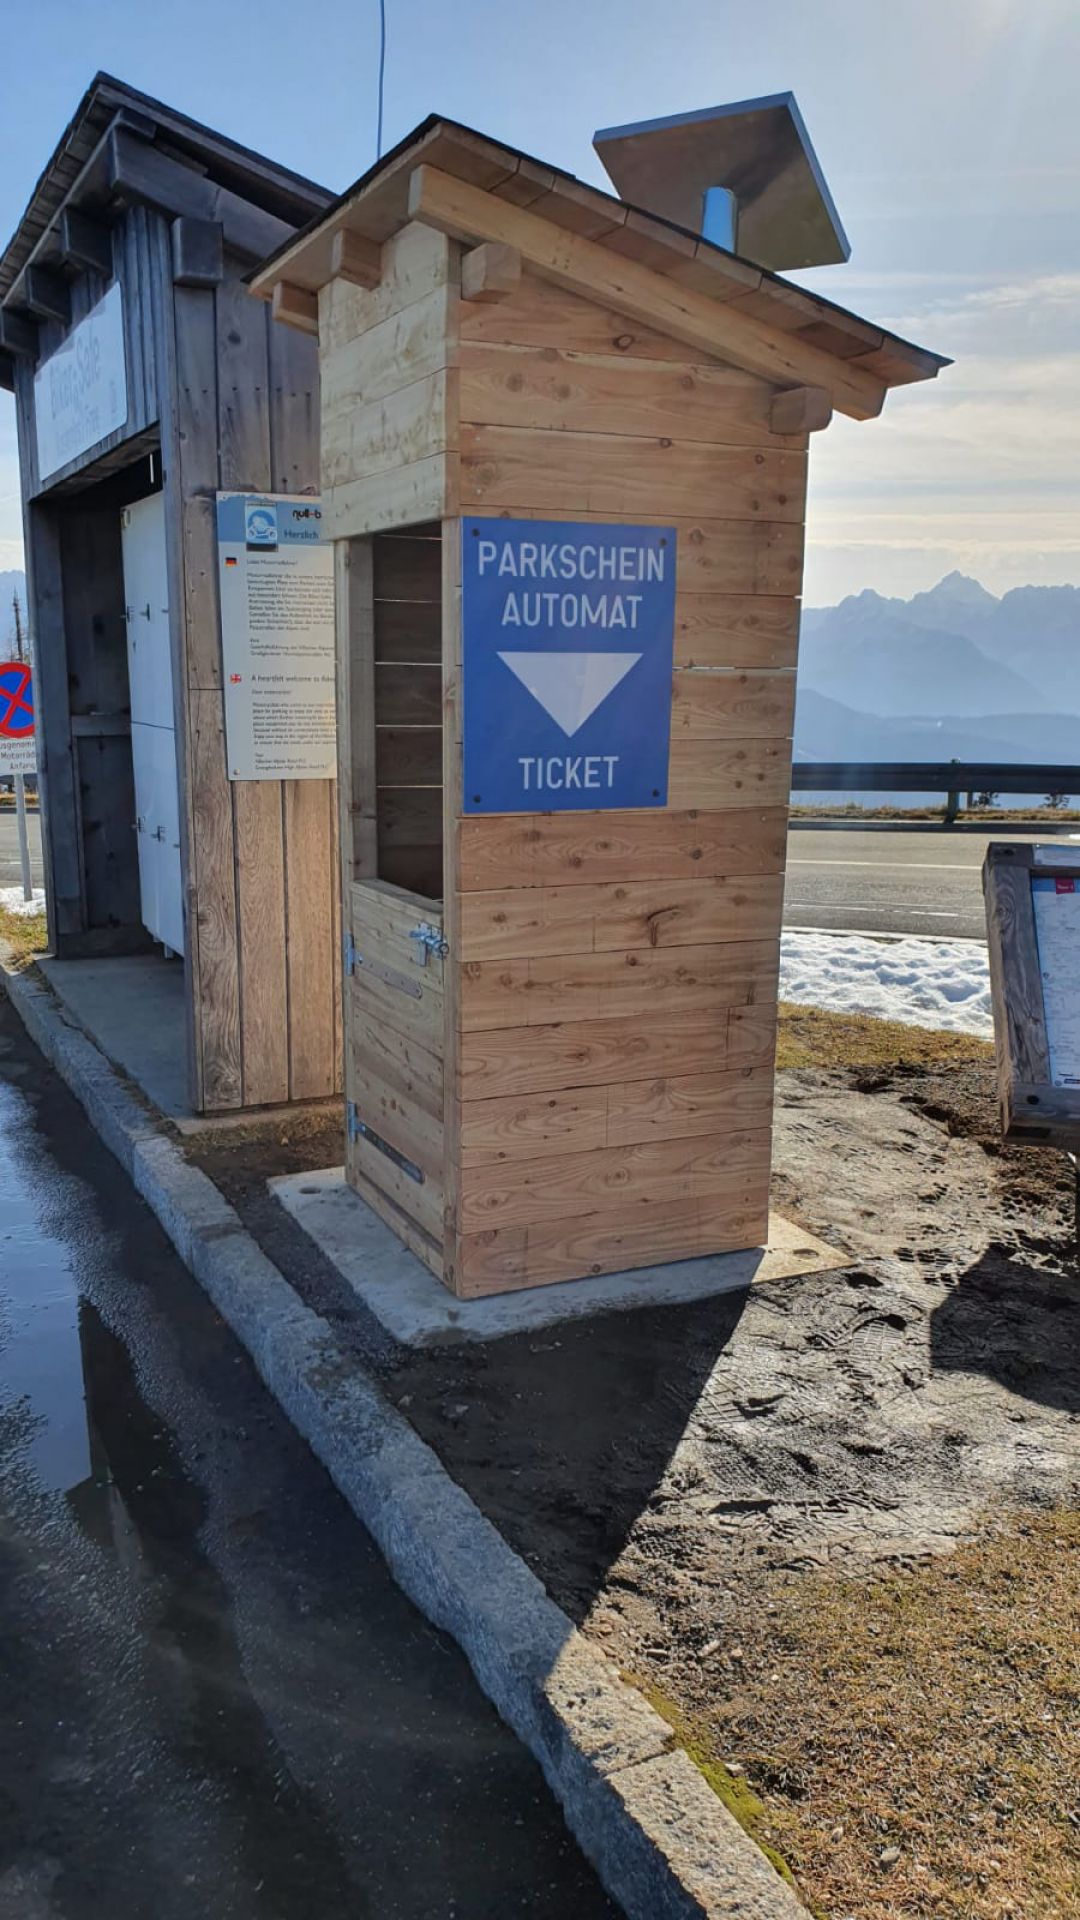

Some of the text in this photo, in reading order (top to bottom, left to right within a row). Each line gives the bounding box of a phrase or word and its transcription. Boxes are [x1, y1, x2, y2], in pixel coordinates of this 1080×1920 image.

[478, 540, 665, 582] PARKSCHEIN
[502, 592, 643, 629] AUTOMAT
[518, 755, 619, 790] TICKET
